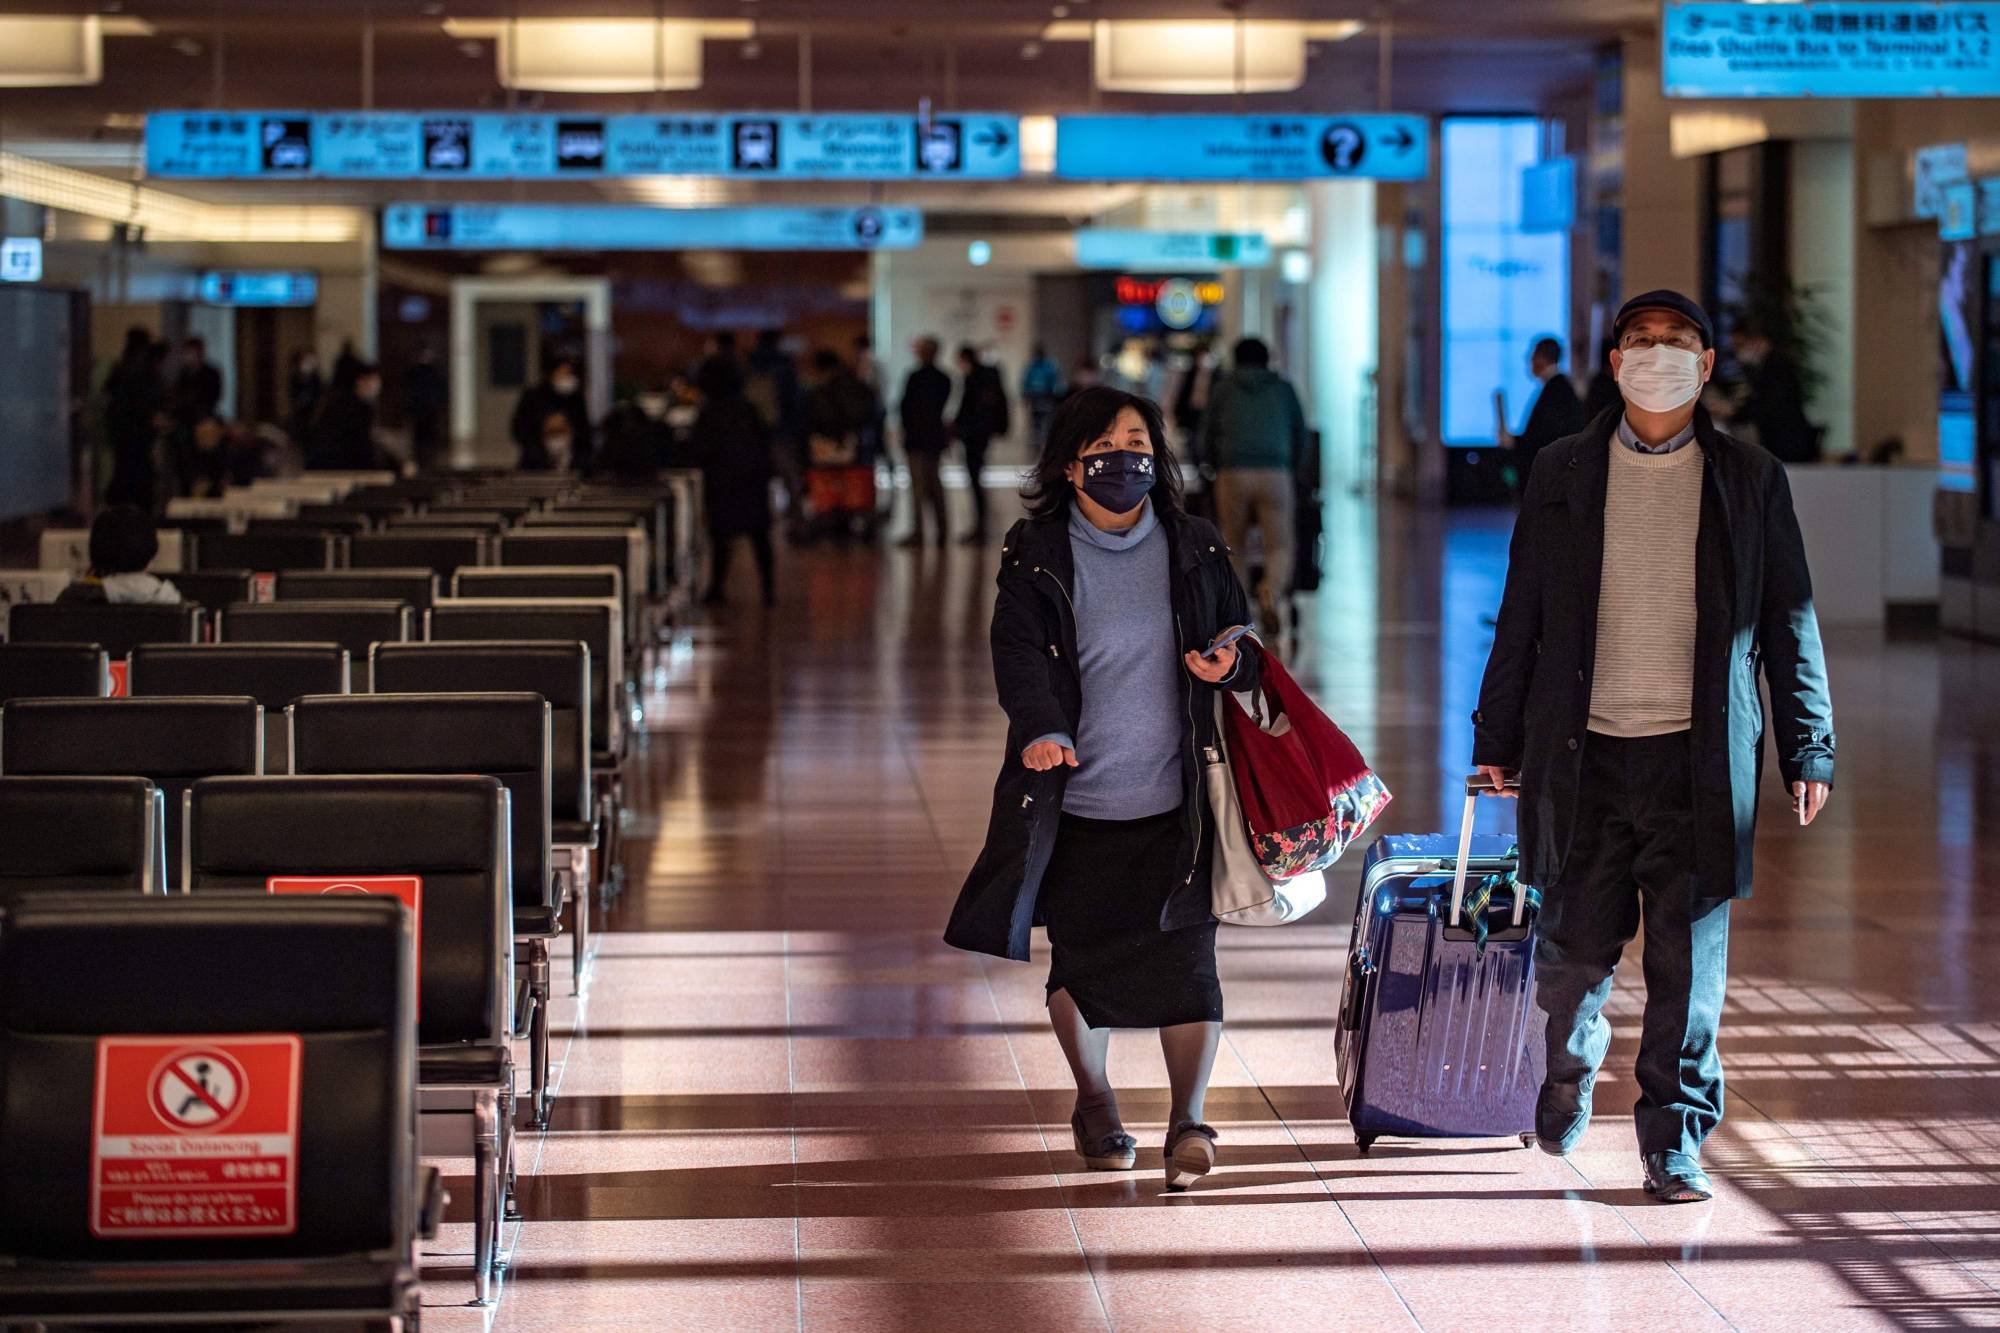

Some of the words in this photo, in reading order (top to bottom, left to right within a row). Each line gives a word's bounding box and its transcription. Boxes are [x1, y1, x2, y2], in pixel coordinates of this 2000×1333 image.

[1716, 37, 1789, 56] Shuttle
[1795, 38, 1829, 55] Bus
[1837, 38, 1859, 55] to
[1866, 37, 1948, 55] Terminal
[130, 1140, 175, 1154] Social
[181, 1140, 261, 1157] Distancing
